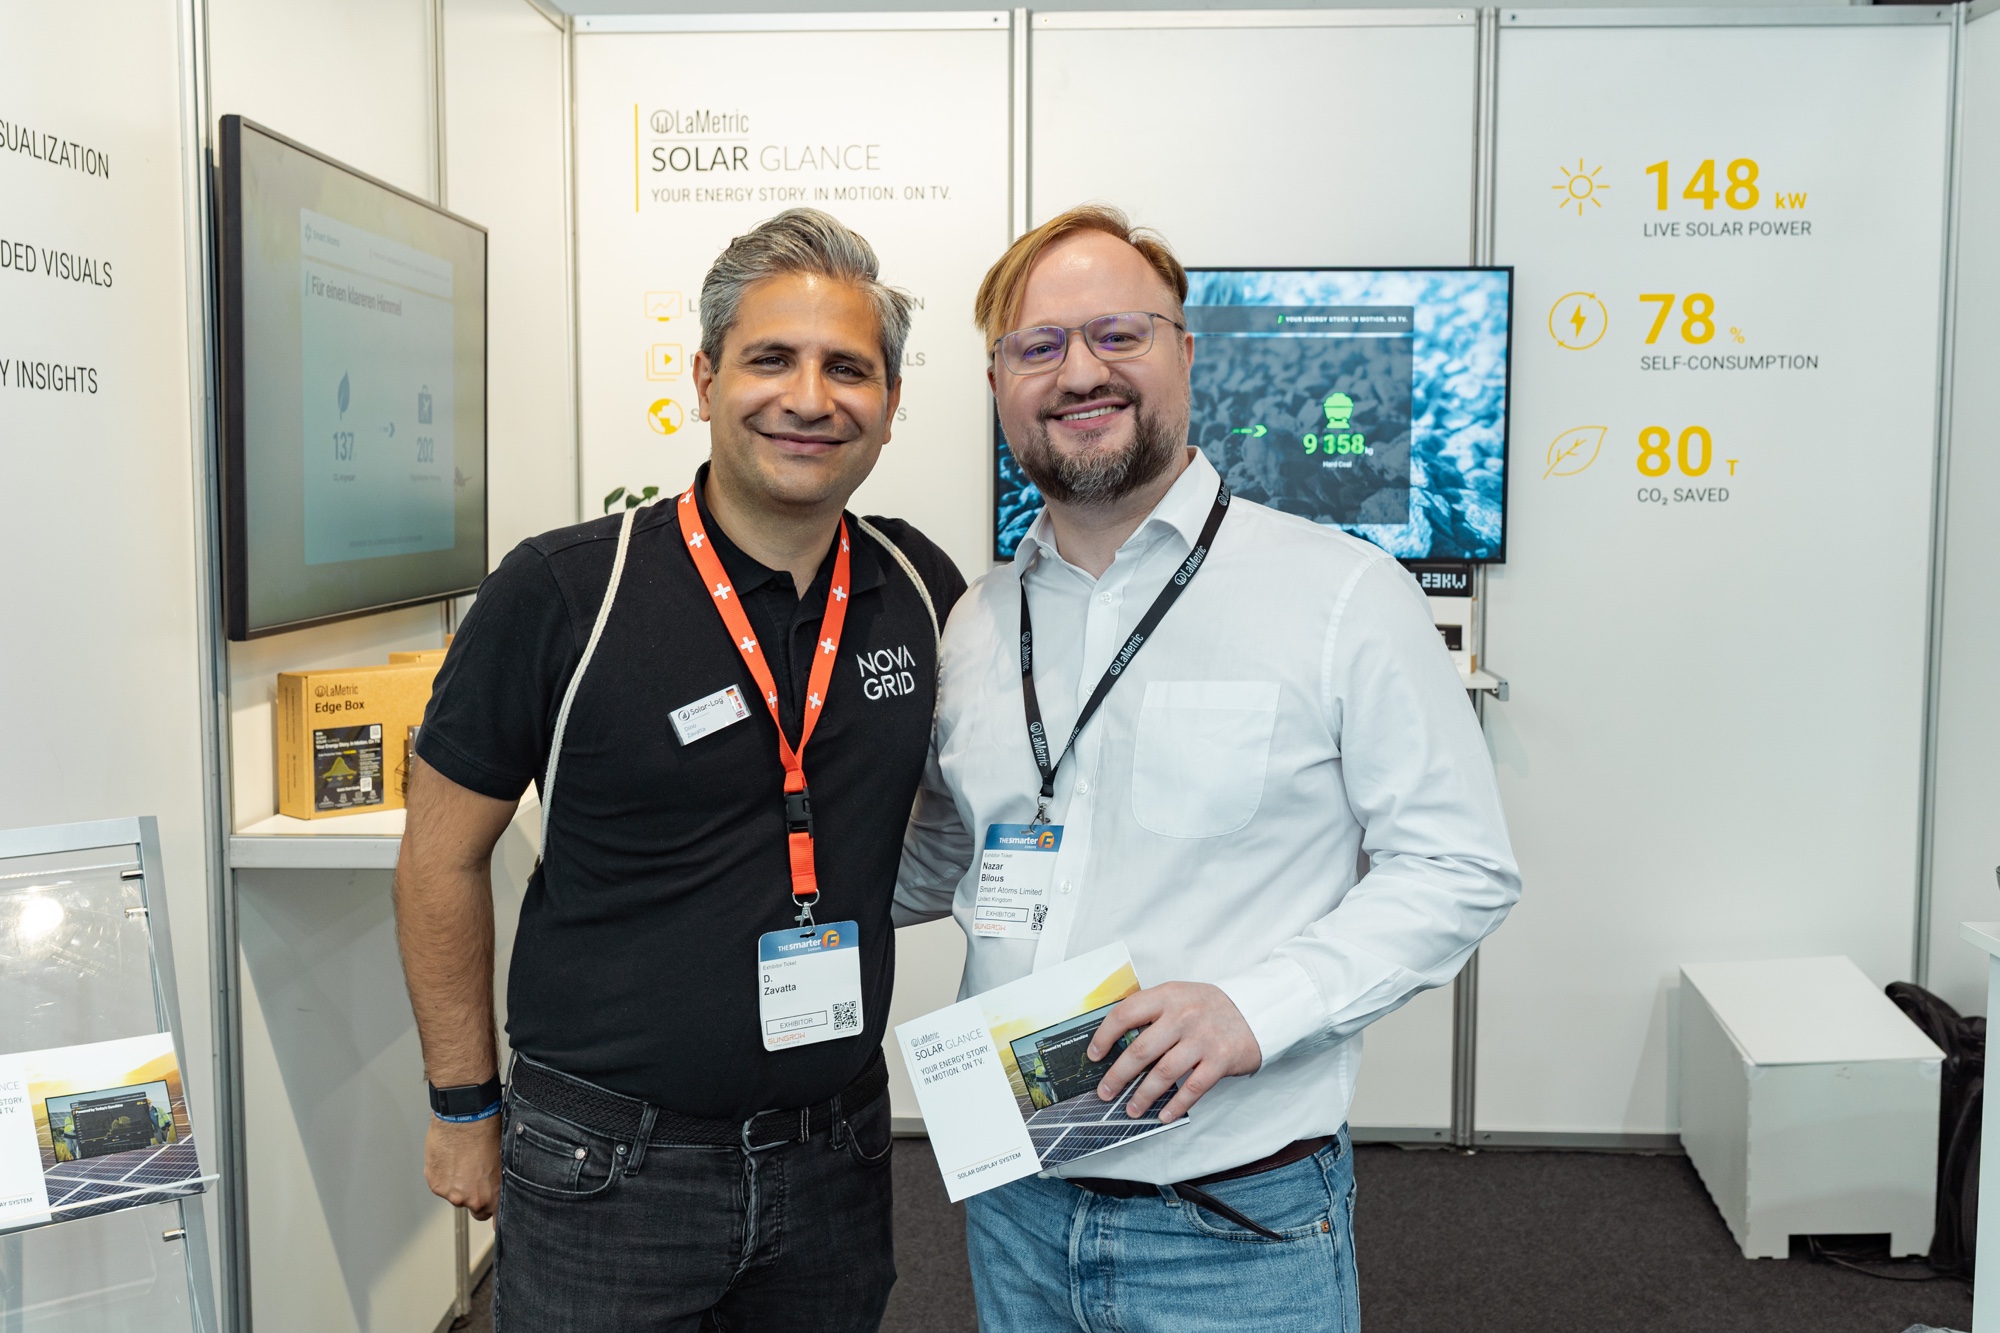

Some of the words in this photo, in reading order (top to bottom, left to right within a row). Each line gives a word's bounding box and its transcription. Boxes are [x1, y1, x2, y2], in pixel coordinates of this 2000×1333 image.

[676, 109, 749, 134] LaMetric
[652, 146, 749, 172] SOLAR
[759, 144, 881, 172] GLANCE
[651, 188, 691, 202] YOUR
[696, 188, 754, 202] ENERGY
[759, 187, 809, 202] STORY.
[814, 187, 829, 201] IN
[834, 186, 898, 201] MOTION.
[904, 186, 925, 201] ON
[931, 186, 952, 200] TV.
[1645, 158, 1760, 211] 148
[1775, 192, 1807, 209] kW
[1643, 222, 1681, 238] LIVE
[1686, 222, 1743, 237] SOLAR
[1749, 221, 1812, 236] POWER
[42, 248, 113, 288] VISUALS
[312, 275, 325, 297] Für
[326, 280, 347, 303] einen
[347, 285, 376, 310] klareren
[1639, 292, 1716, 345] 78
[1729, 327, 1746, 344] %
[16, 359, 98, 394] INSIGHTS
[1640, 355, 1819, 371] SELF-CONSUMPTION
[333, 431, 354, 461] 137
[1636, 425, 1713, 478] 80
[1726, 459, 1740, 477] T
[1673, 488, 1730, 502] SAVED
[1180, 545, 1207, 580] LaMetric
[856, 645, 916, 678] NOVA
[1020, 642, 1032, 672] LaMetric
[1116, 633, 1144, 667] LaMetric
[326, 685, 359, 697] LaMetric
[863, 671, 916, 701] GRID
[315, 702, 342, 714] Edge
[345, 700, 365, 711] Box
[1031, 732, 1048, 768] LaMetric
[981, 874, 1005, 883] Bilous
[982, 862, 1004, 871] Nazar
[979, 886, 996, 894] Smart
[997, 887, 1018, 895] Atoms
[1019, 888, 1043, 896] Limited
[985, 910, 1016, 918] EXHIBITOR
[763, 975, 773, 983] D.
[764, 984, 797, 996] Zavatta
[780, 1017, 814, 1029] EXHIBITOR
[915, 1043, 945, 1061] SOLAR
[945, 1028, 983, 1050] GLANCE
[918, 1031, 940, 1046] LaMetric
[921, 1063, 939, 1076] YOUR
[940, 1054, 965, 1070] ENERGY
[966, 1045, 991, 1059] STORY.
[924, 1076, 932, 1085] IN
[933, 1066, 961, 1082] MOTION.
[962, 1061, 973, 1071] ON
[973, 1057, 985, 1067] TV.
[957, 1168, 975, 1180] SOLAR
[975, 1160, 998, 1174] DISPLAY
[998, 1152, 1021, 1166] SYSTEM
[8, 1197, 33, 1206] SYSTEM
